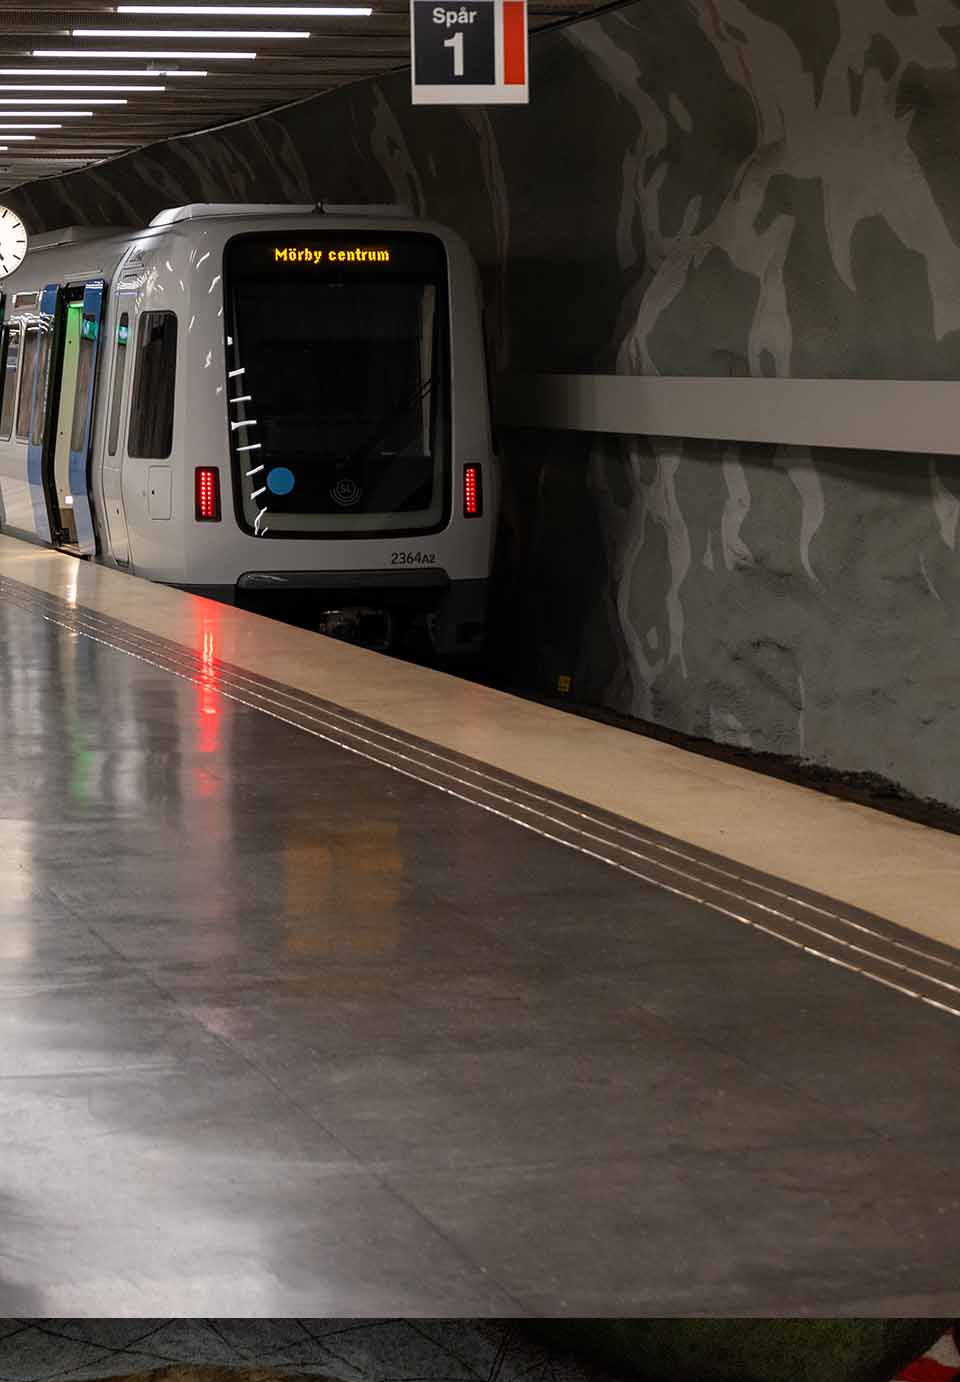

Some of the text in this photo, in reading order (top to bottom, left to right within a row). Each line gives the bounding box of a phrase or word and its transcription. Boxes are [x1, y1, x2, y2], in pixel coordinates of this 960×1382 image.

[432, 6, 478, 29] Spår
[443, 31, 465, 77] 1
[274, 247, 391, 264] Mörby centrum
[340, 483, 352, 494] SL
[390, 551, 436, 565] 2364A2
